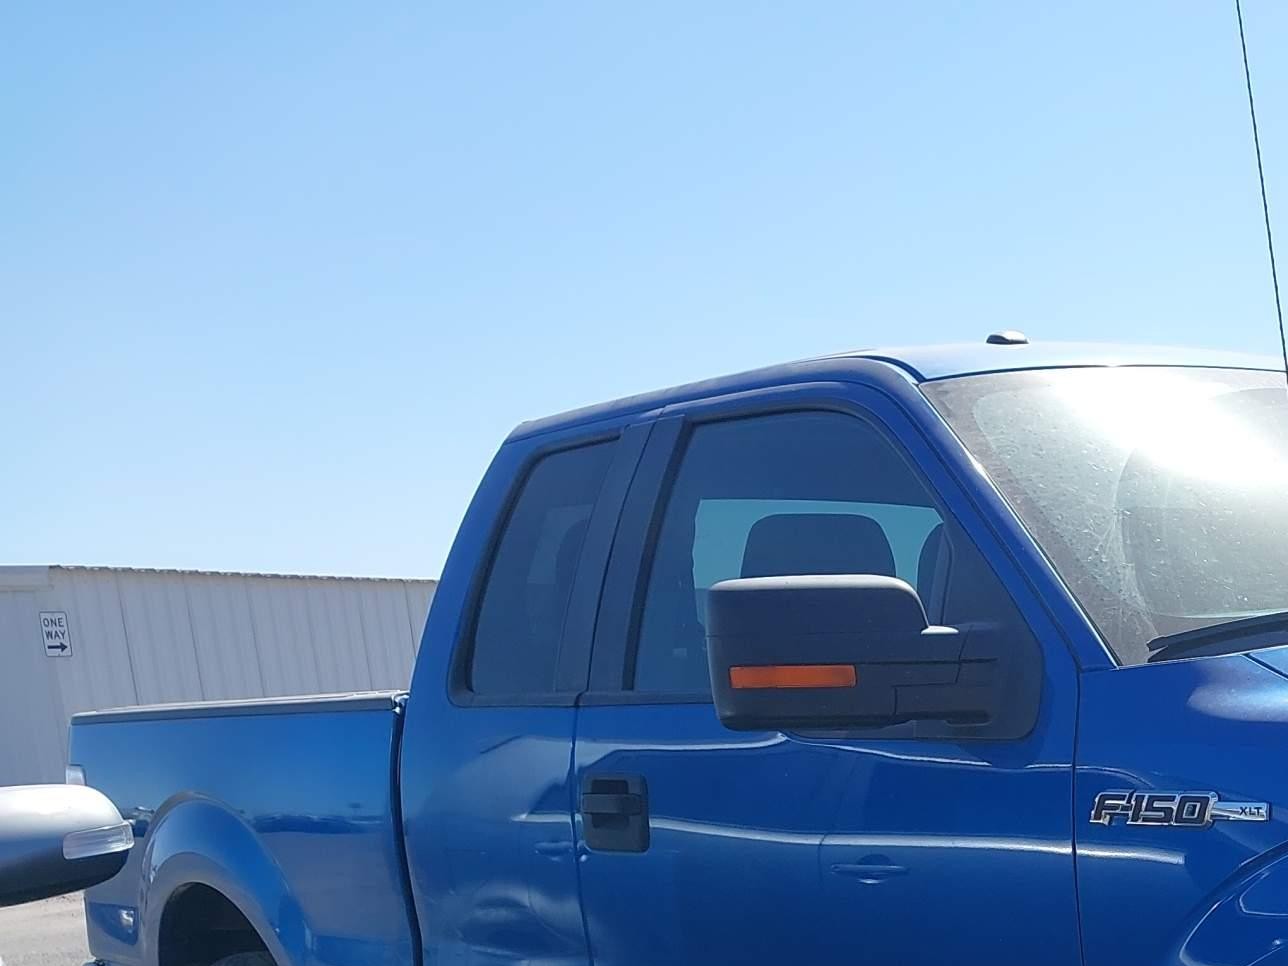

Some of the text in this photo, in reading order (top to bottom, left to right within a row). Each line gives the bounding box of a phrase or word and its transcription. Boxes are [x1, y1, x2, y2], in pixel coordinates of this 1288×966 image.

[42, 617, 65, 628] ONE
[45, 629, 66, 640] WAY
[1239, 806, 1263, 816] XLT
